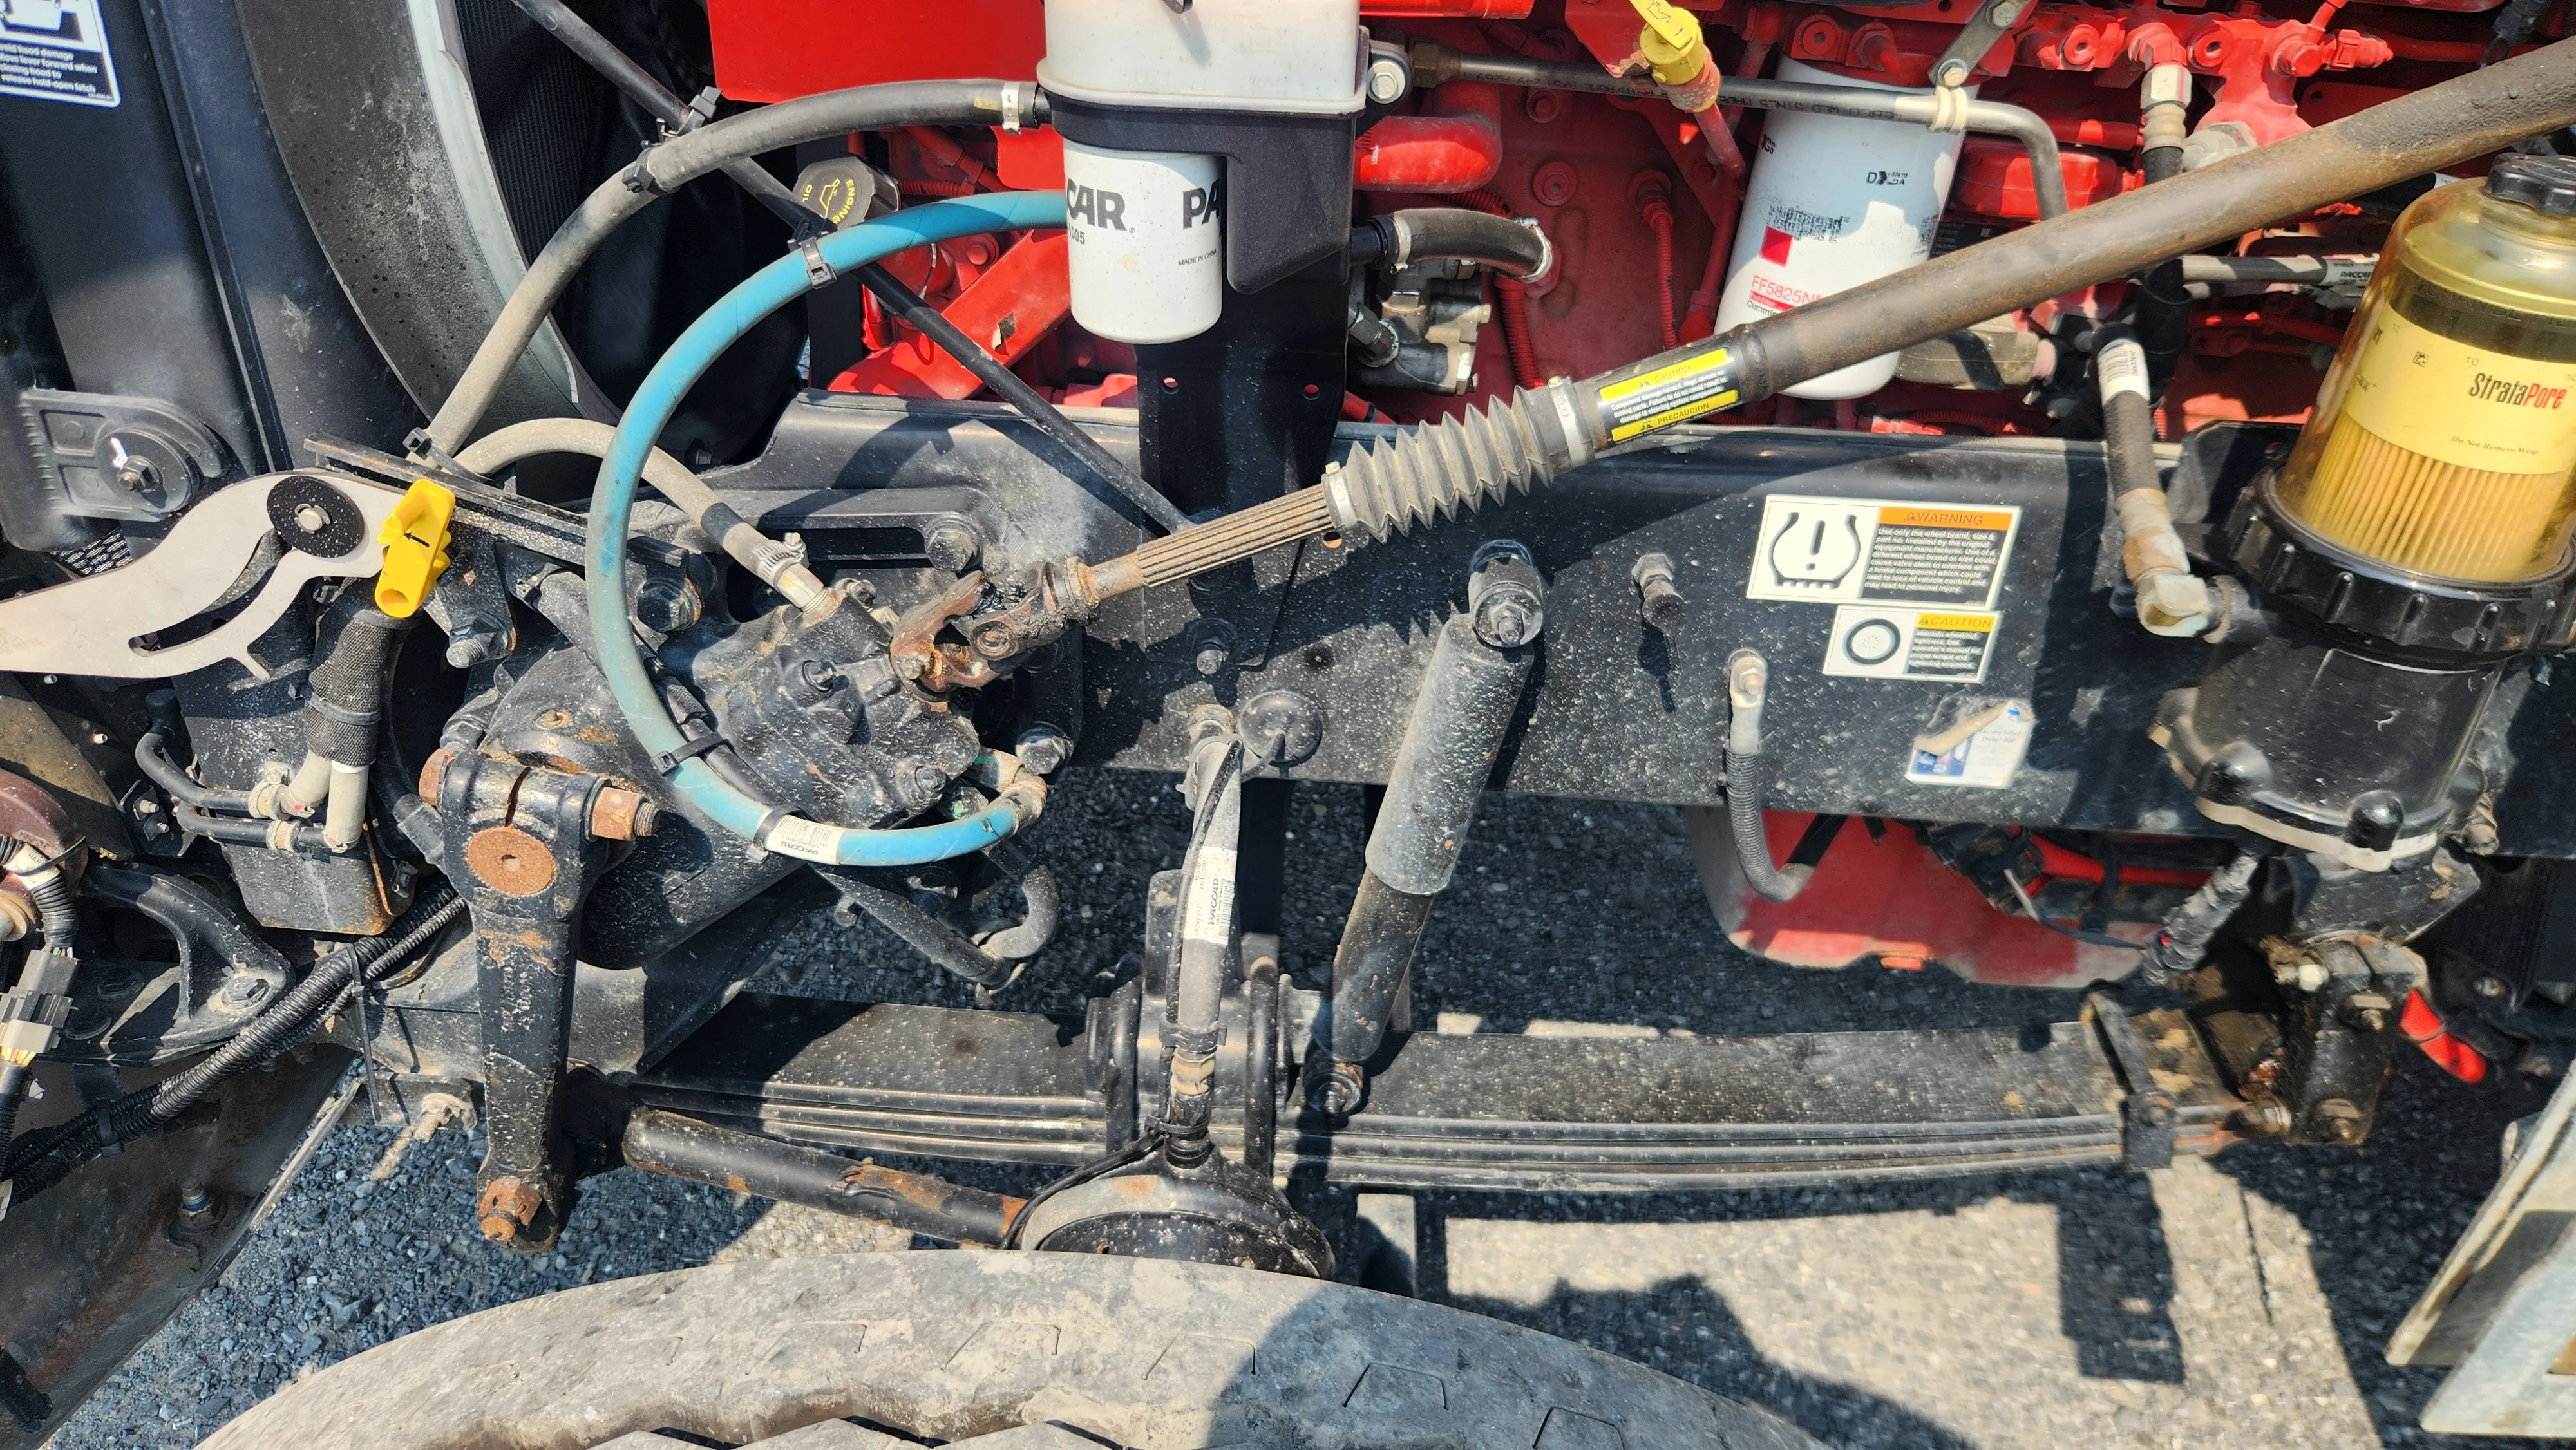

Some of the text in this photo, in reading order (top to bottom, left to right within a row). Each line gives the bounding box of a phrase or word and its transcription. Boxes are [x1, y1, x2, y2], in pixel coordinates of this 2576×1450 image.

[17, 45, 39, 55] hood
[41, 48, 74, 61] damage
[0, 53, 97, 73] ove lever forward when
[29, 66, 51, 77] hood
[52, 70, 62, 79] to
[1, 74, 95, 92] release hold-open latch
[802, 184, 813, 203] OIL
[832, 178, 855, 224] ENGINE
[1178, 256, 1197, 266] MADE
[1752, 274, 1822, 305] FF5825N
[2466, 356, 2479, 366] 10
[1654, 365, 1690, 383] CAUTION
[1611, 395, 1641, 411] Component
[1642, 390, 1663, 401] damage
[1683, 378, 1698, 388] Align
[1697, 372, 1716, 382] arrows
[2469, 372, 2567, 410] StrataPore
[1613, 408, 1633, 419] mating
[1649, 396, 1667, 407] Failure
[1689, 384, 1704, 393] could
[1703, 378, 1720, 388] result
[1648, 403, 1671, 415] steering
[1670, 397, 1690, 408] system
[1657, 402, 1709, 425] PRECAUCION
[2467, 439, 2481, 447] Not
[2483, 442, 2515, 453] Remove
[1917, 512, 1984, 525] WARNING
[1879, 527, 1893, 535] Use
[1894, 528, 1910, 538] only
[1911, 528, 1924, 536] the
[1924, 529, 1946, 538] wheel
[1972, 532, 1987, 541] size
[1874, 543, 1913, 552] equipment
[1875, 536, 1891, 544] part
[1906, 537, 1937, 546] installed
[1938, 538, 1947, 547] by
[1948, 539, 1961, 547] the
[1961, 540, 1990, 549] original
[1872, 551, 1903, 559] different
[1904, 552, 1925, 560] wheel
[1926, 553, 1947, 561] brand
[1958, 555, 1974, 563] size
[1974, 555, 1996, 565] could
[1874, 566, 1895, 574] brake
[1896, 567, 1937, 577] component
[1938, 569, 1960, 578] which
[1960, 570, 1982, 579] could
[1942, 561, 1973, 570] interfere
[1973, 563, 1991, 572] with
[1864, 581, 1880, 590] may
[1906, 584, 1938, 592] personal
[1918, 575, 1944, 585] vehicle
[1944, 578, 1971, 587] control
[1971, 579, 1987, 587] and
[1930, 617, 1993, 628] CAUTION
[1910, 652, 1933, 661] proper
[1933, 653, 1955, 661] torque
[1946, 646, 1970, 654] manual
[781, 841, 819, 855] PACCAR
[1208, 878, 1219, 925] PACCAR
